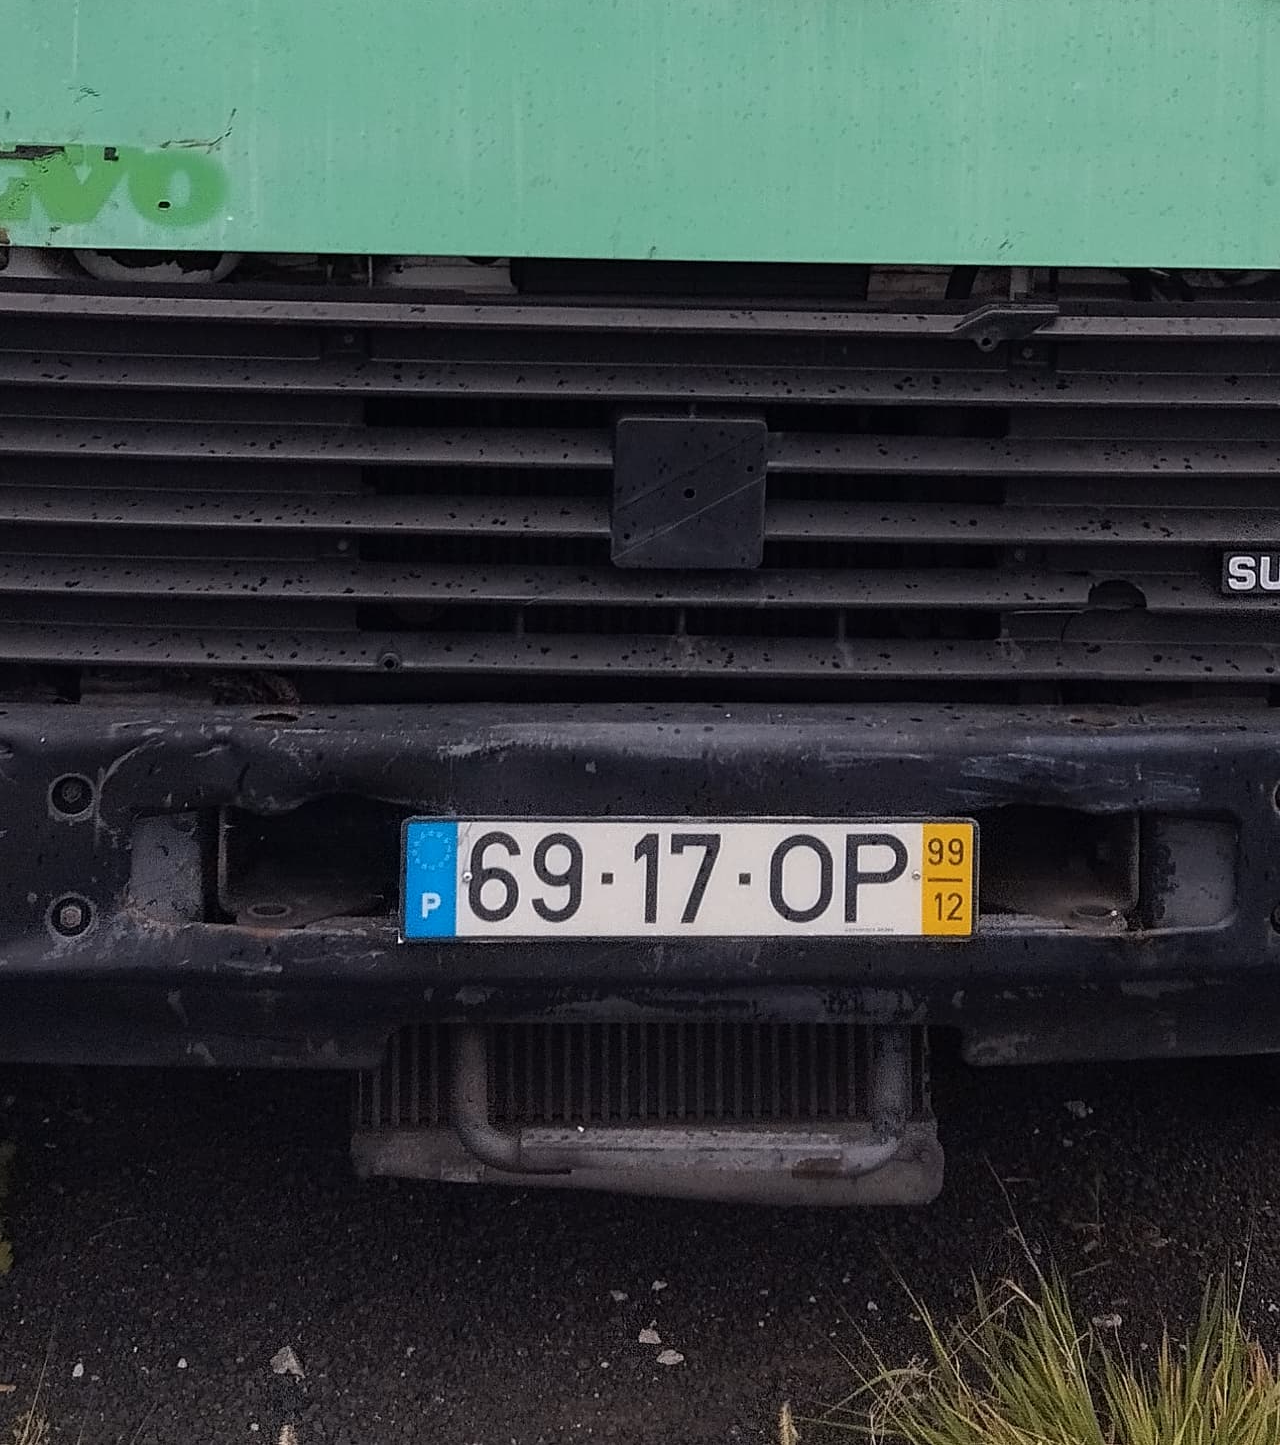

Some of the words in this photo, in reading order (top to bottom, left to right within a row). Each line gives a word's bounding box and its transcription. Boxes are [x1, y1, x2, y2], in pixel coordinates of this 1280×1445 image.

[926, 838, 965, 866] 99
[420, 893, 441, 919] P
[932, 893, 964, 921] 12
